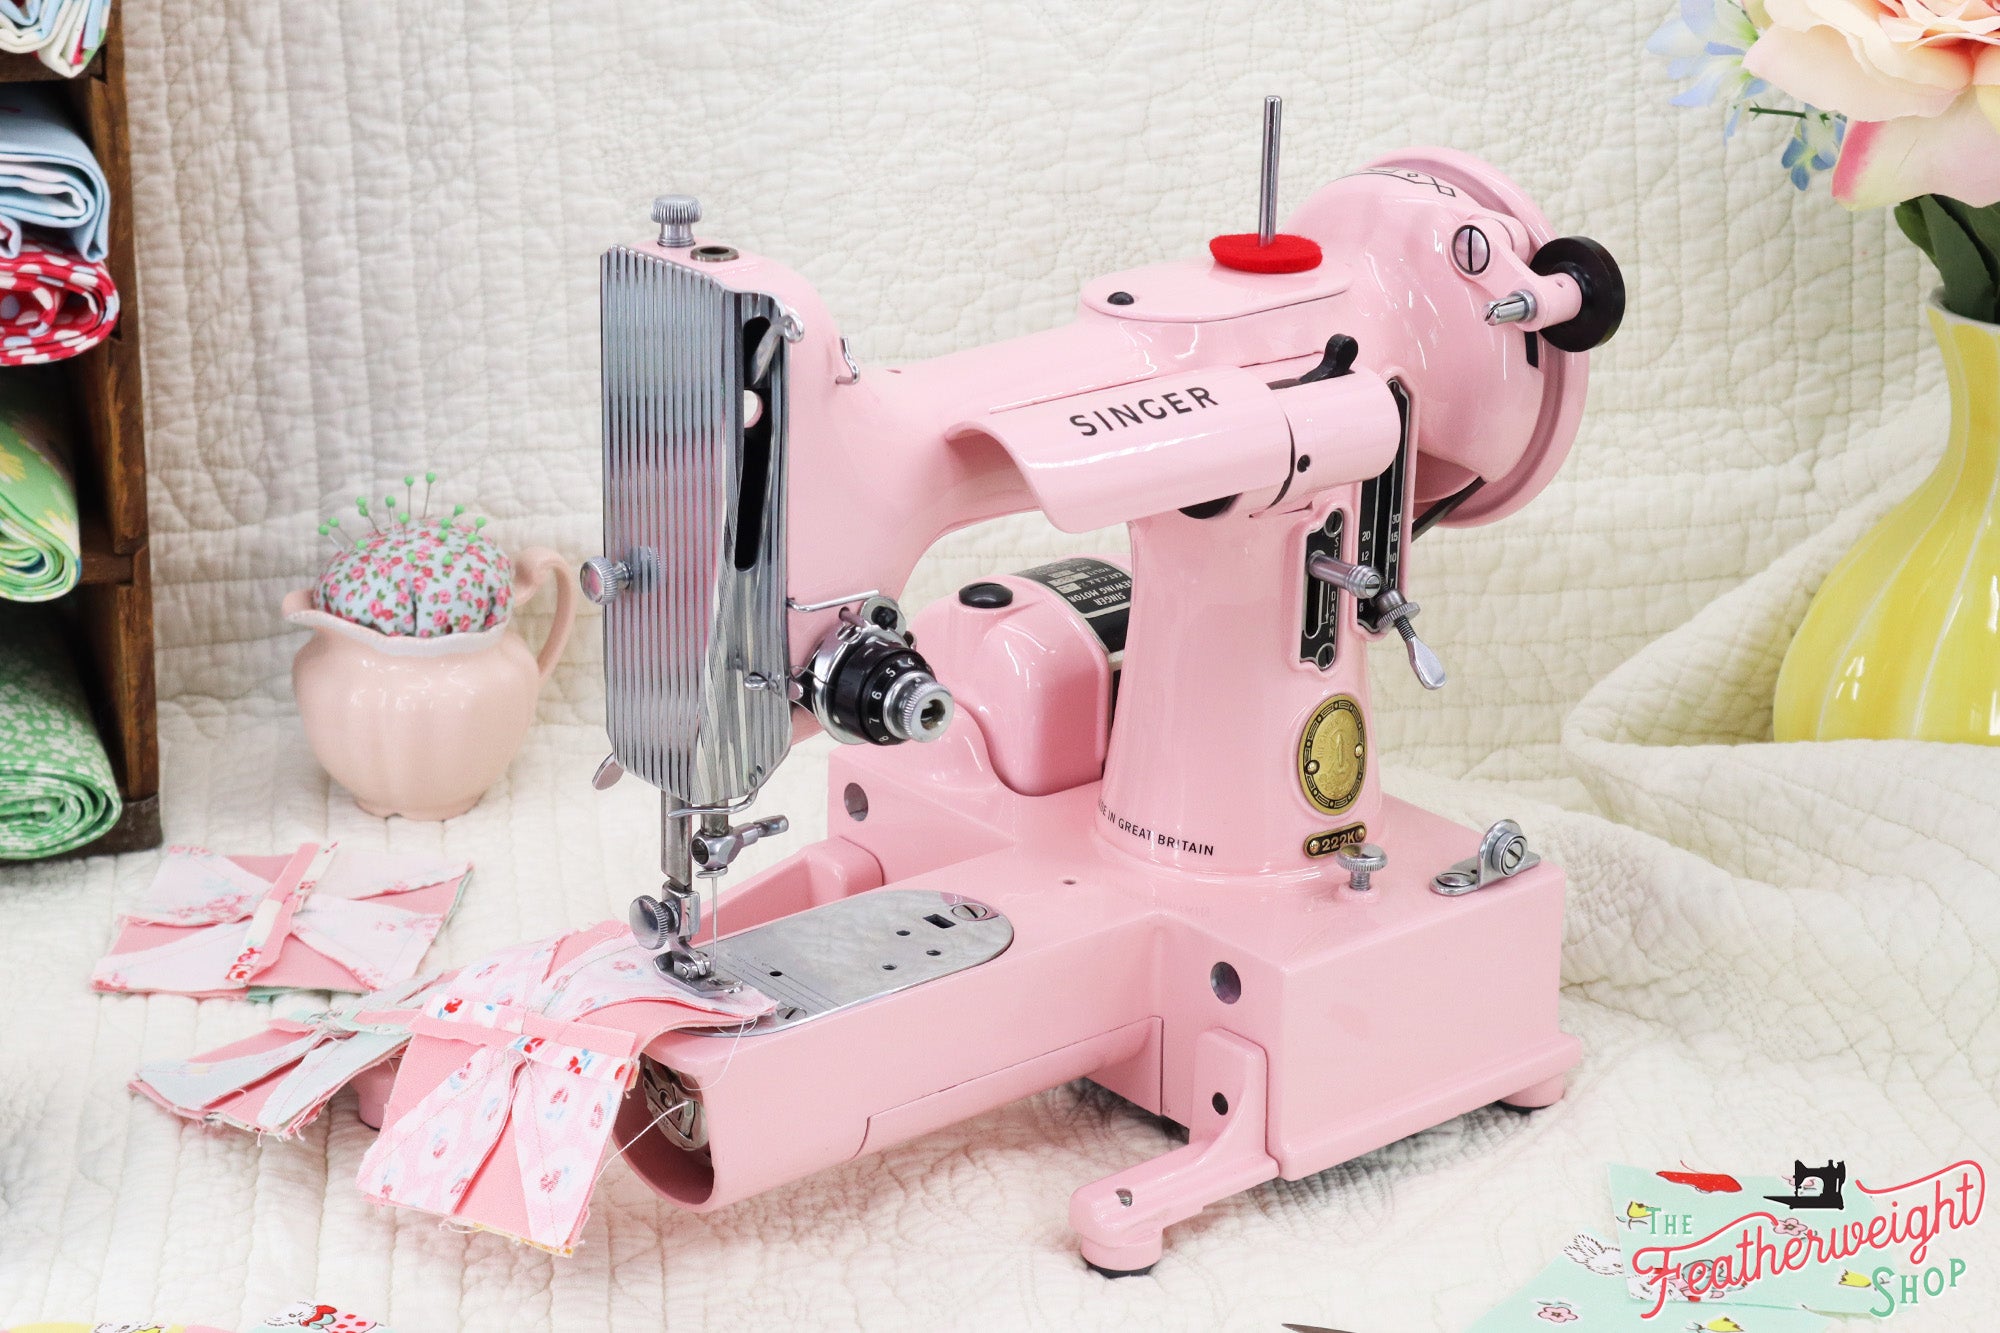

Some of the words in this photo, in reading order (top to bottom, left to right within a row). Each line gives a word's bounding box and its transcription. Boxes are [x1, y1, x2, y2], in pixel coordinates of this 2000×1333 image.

[1069, 386, 1219, 436] SINGER
[1362, 531, 1370, 542] 20
[1391, 532, 1398, 543] 15
[1361, 550, 1370, 562] 12
[1389, 552, 1397, 563] 10
[1067, 591, 1100, 603] MOTOR
[1093, 592, 1127, 606] SINGER
[1329, 591, 1337, 638] DARN
[885, 667, 897, 678] 5
[871, 690, 882, 700] 6
[868, 716, 880, 725] 7
[878, 735, 889, 743] 8
[1107, 809, 1116, 823] IN
[1118, 817, 1152, 841] GREAT
[1157, 834, 1214, 856] BRITAIN
[1321, 830, 1355, 851] 222K
